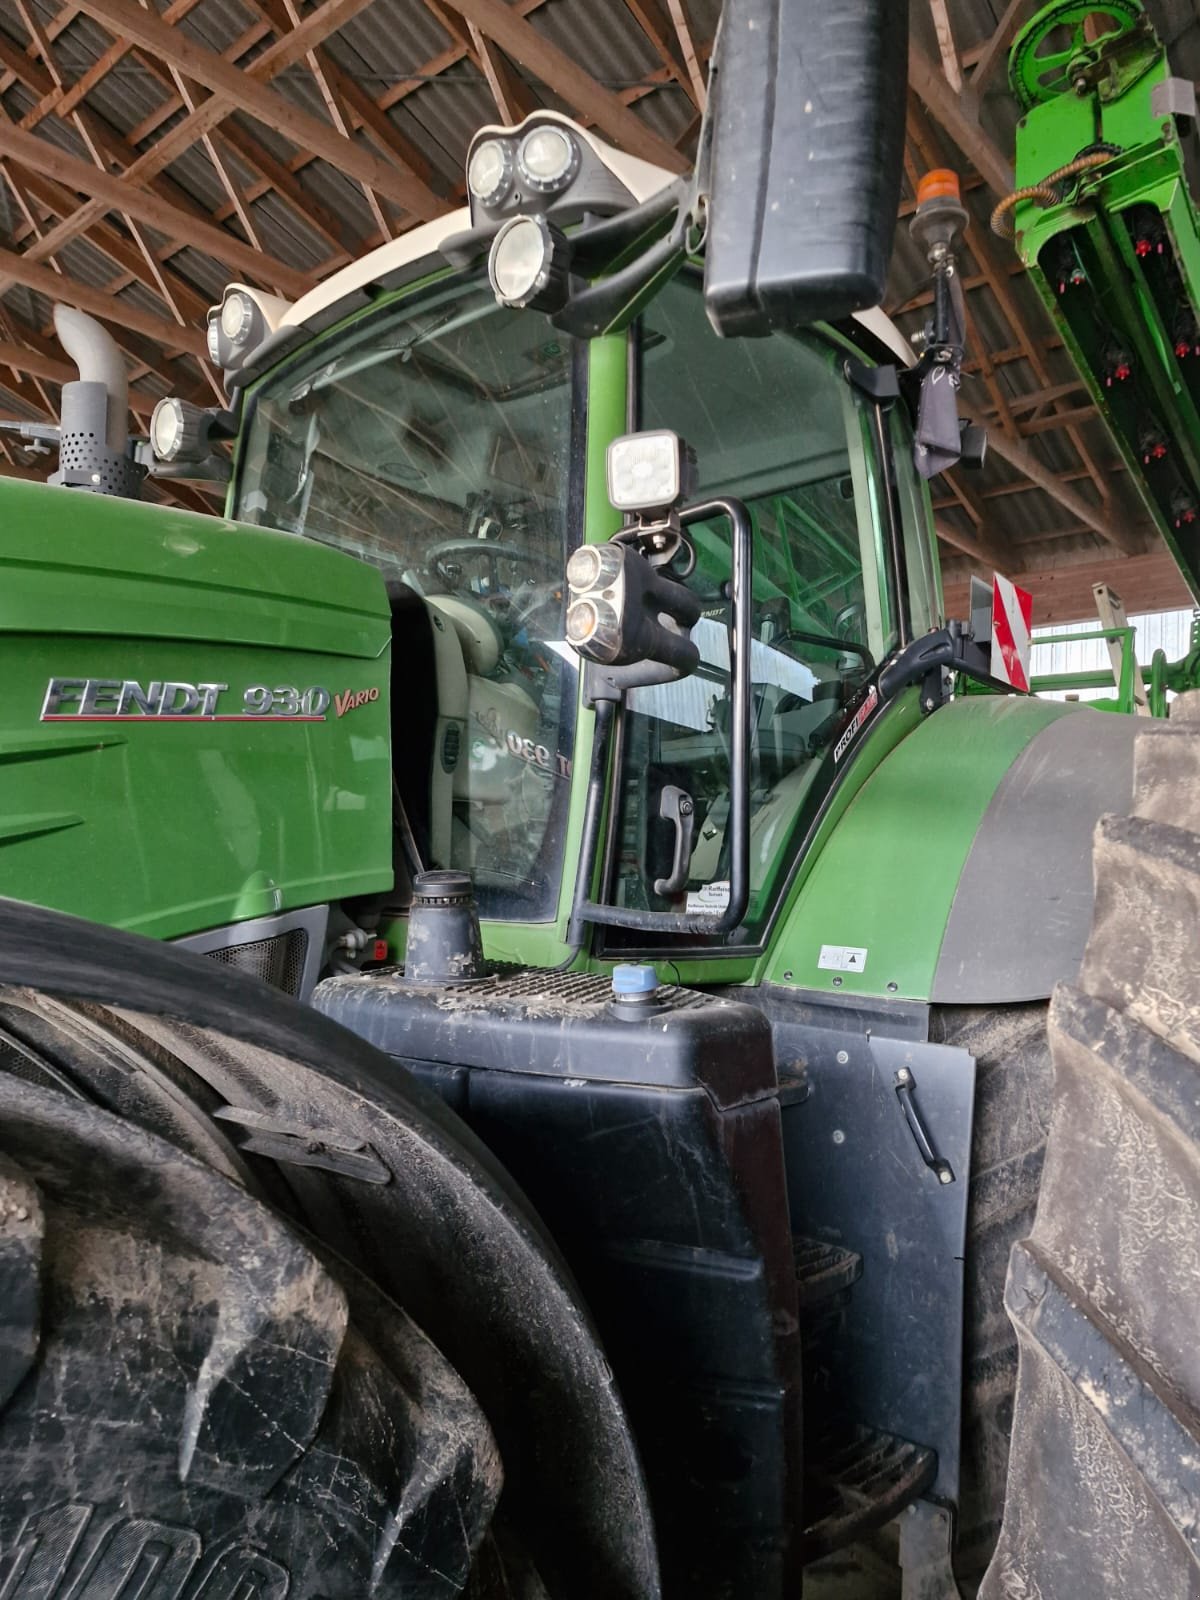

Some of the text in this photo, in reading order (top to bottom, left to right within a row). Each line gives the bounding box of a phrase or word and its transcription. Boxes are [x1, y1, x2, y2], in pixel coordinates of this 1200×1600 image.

[41, 678, 379, 717] FENDT 930 VARIO
